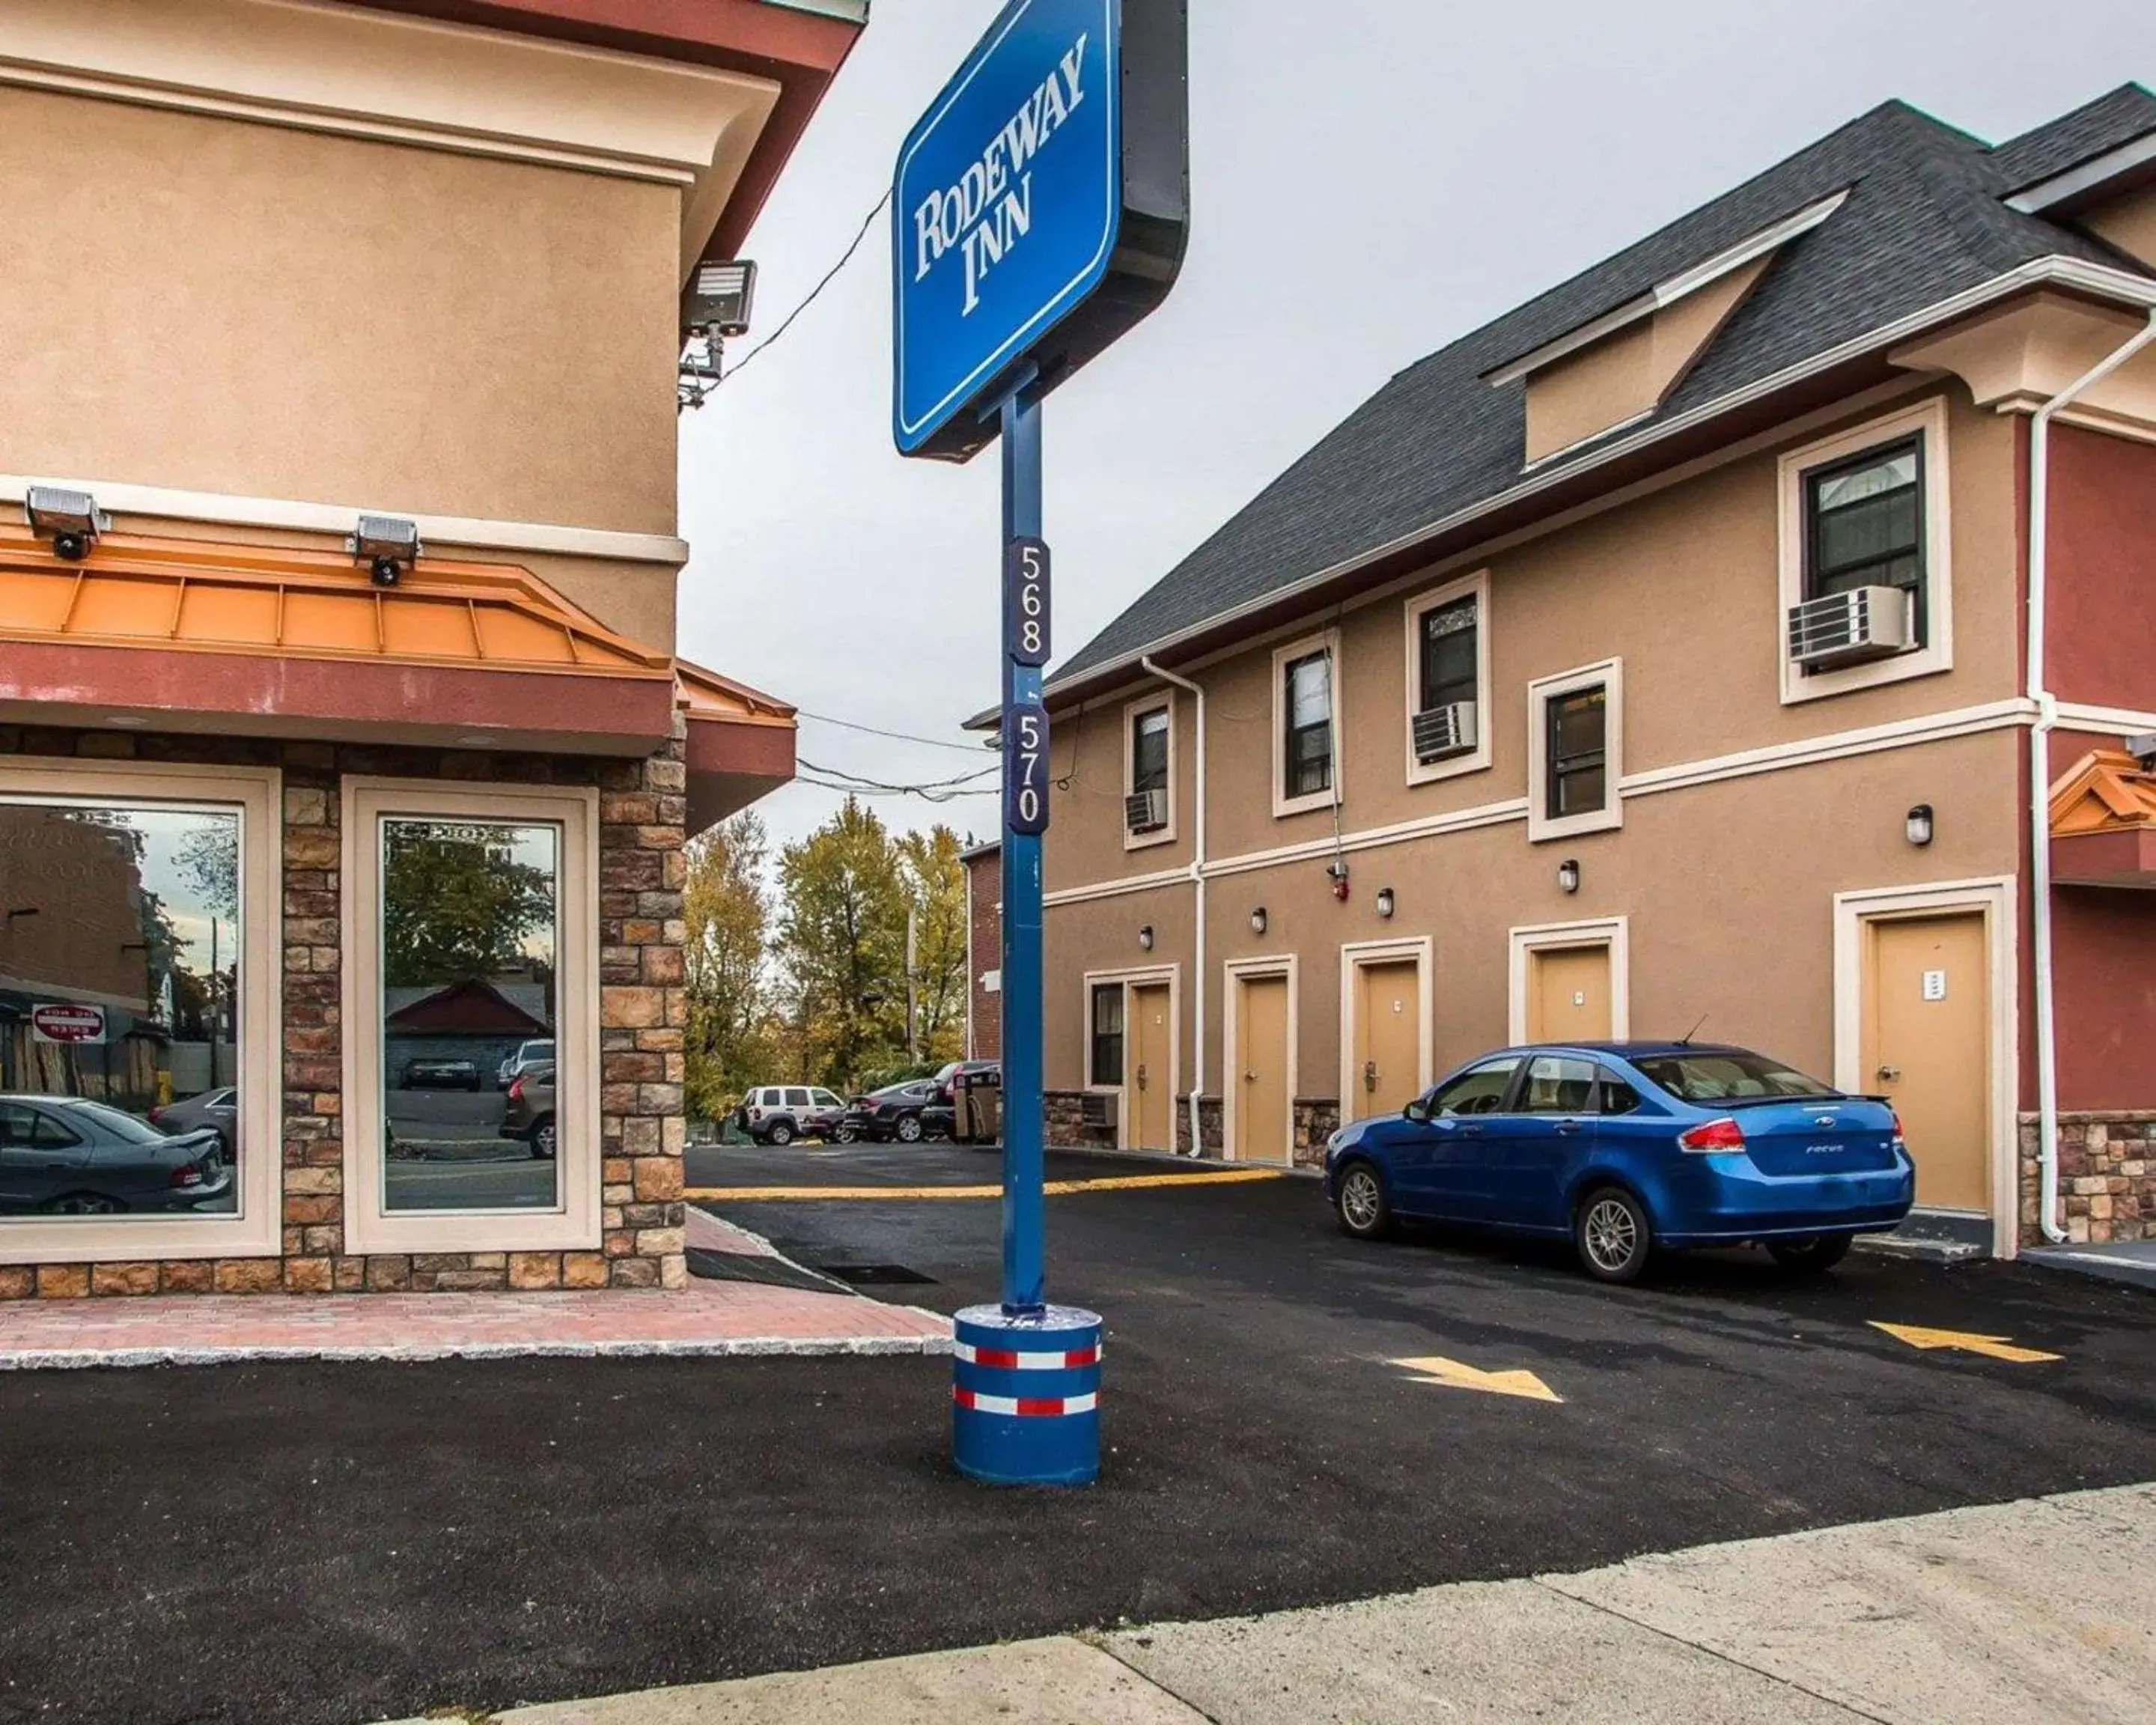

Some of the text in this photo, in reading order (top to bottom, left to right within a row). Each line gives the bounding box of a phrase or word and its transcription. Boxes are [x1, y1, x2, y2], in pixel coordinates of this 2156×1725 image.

[915, 32, 1087, 283] RODEWAY
[961, 169, 1032, 317] INN
[1022, 547, 1041, 654] 568
[1019, 716, 1040, 822] 570
